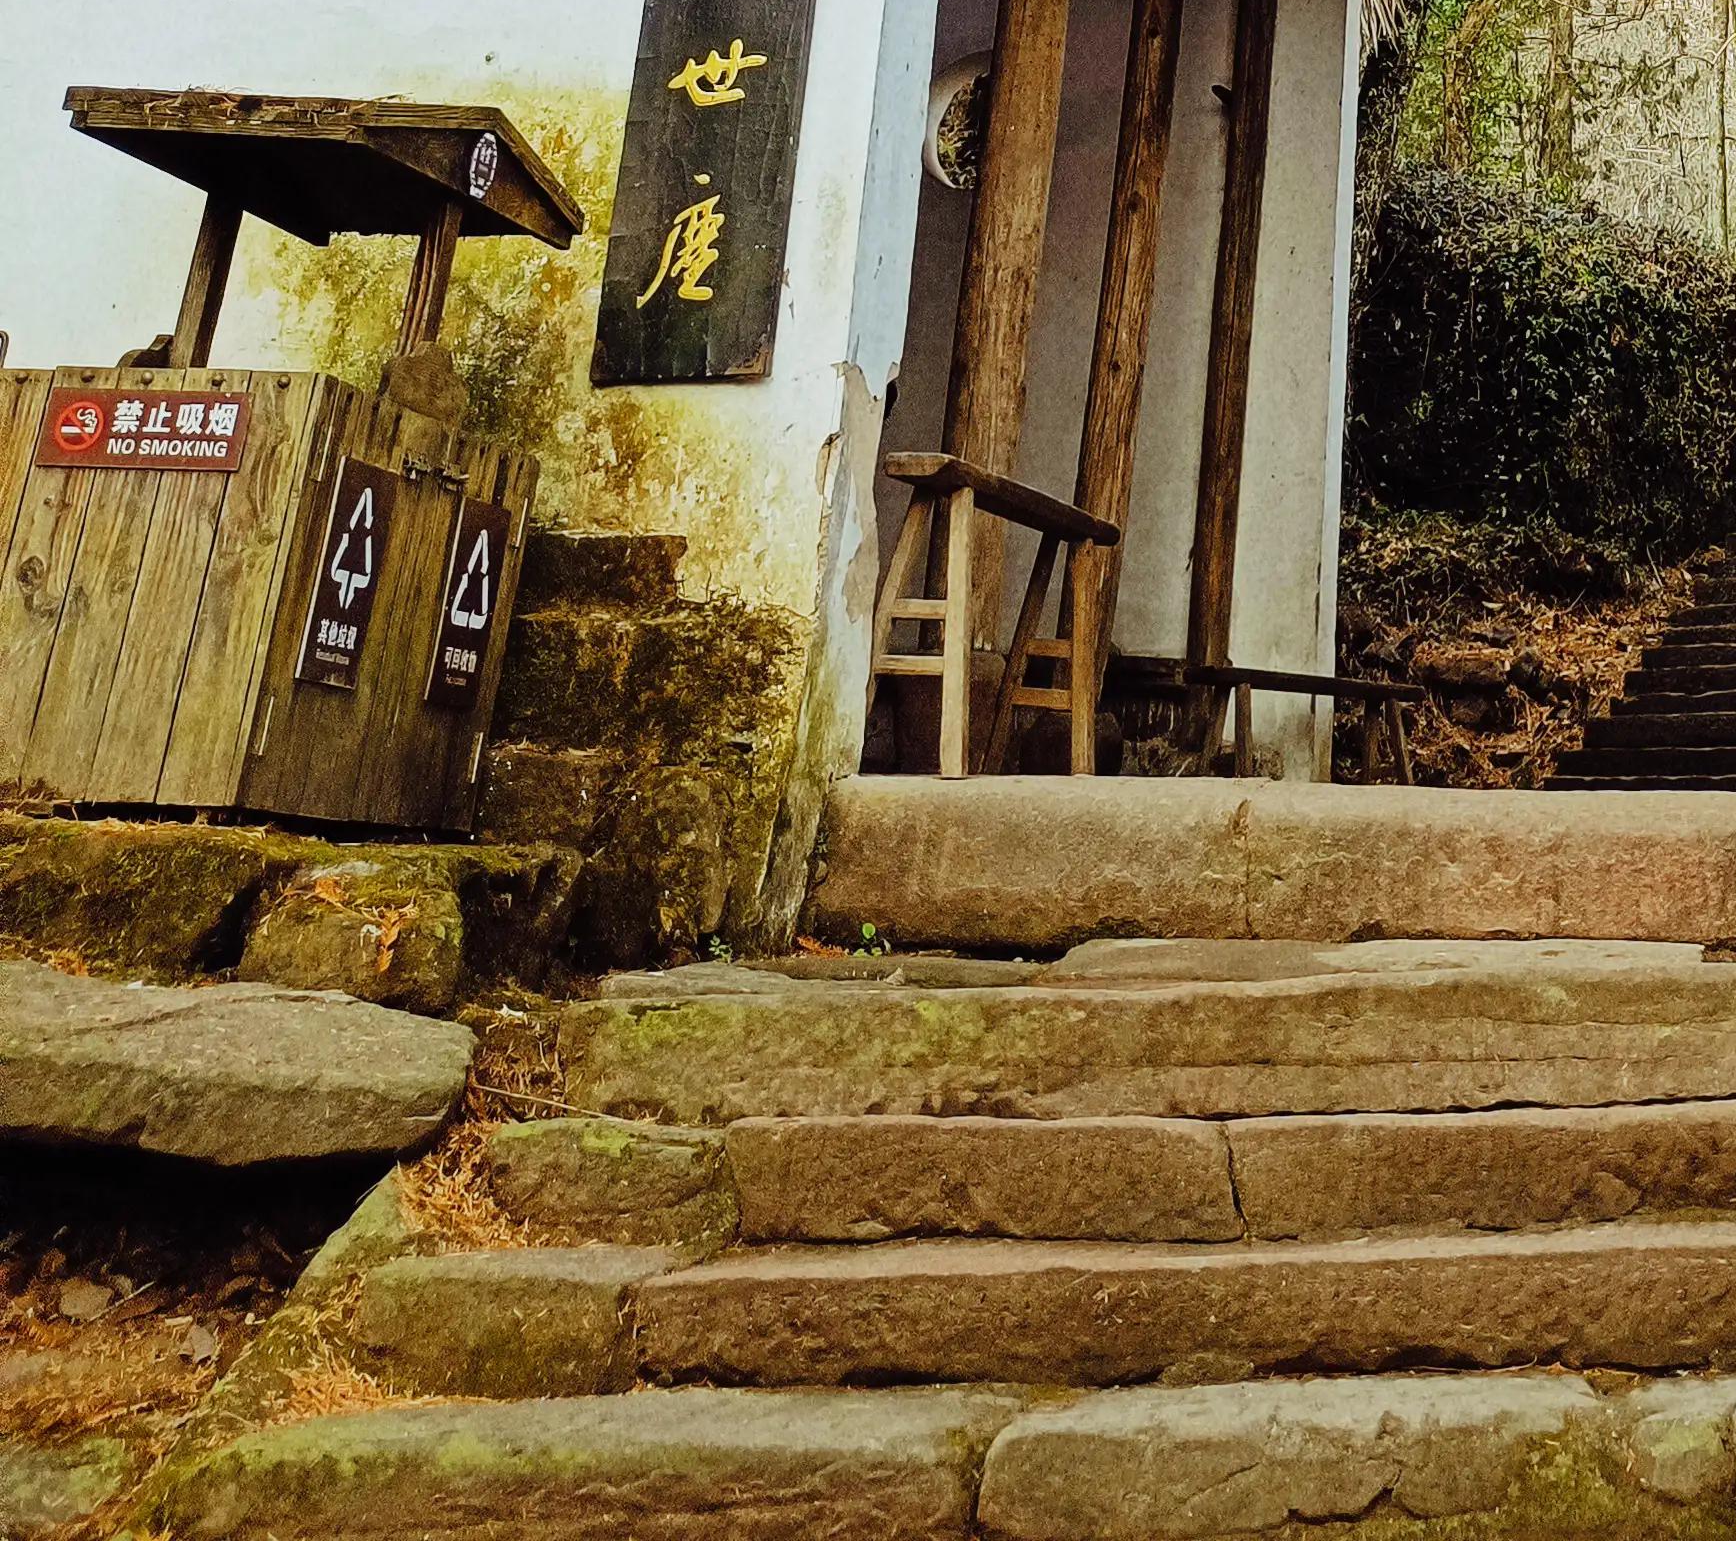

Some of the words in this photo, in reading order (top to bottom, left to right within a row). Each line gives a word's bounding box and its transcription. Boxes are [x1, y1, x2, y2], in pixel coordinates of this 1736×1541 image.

[110, 398, 241, 437] 禁止吸烟
[106, 437, 136, 455] NO
[138, 438, 229, 458] SMOKING
[316, 617, 358, 650] 其他垃圾
[444, 646, 478, 674] 可回收物
